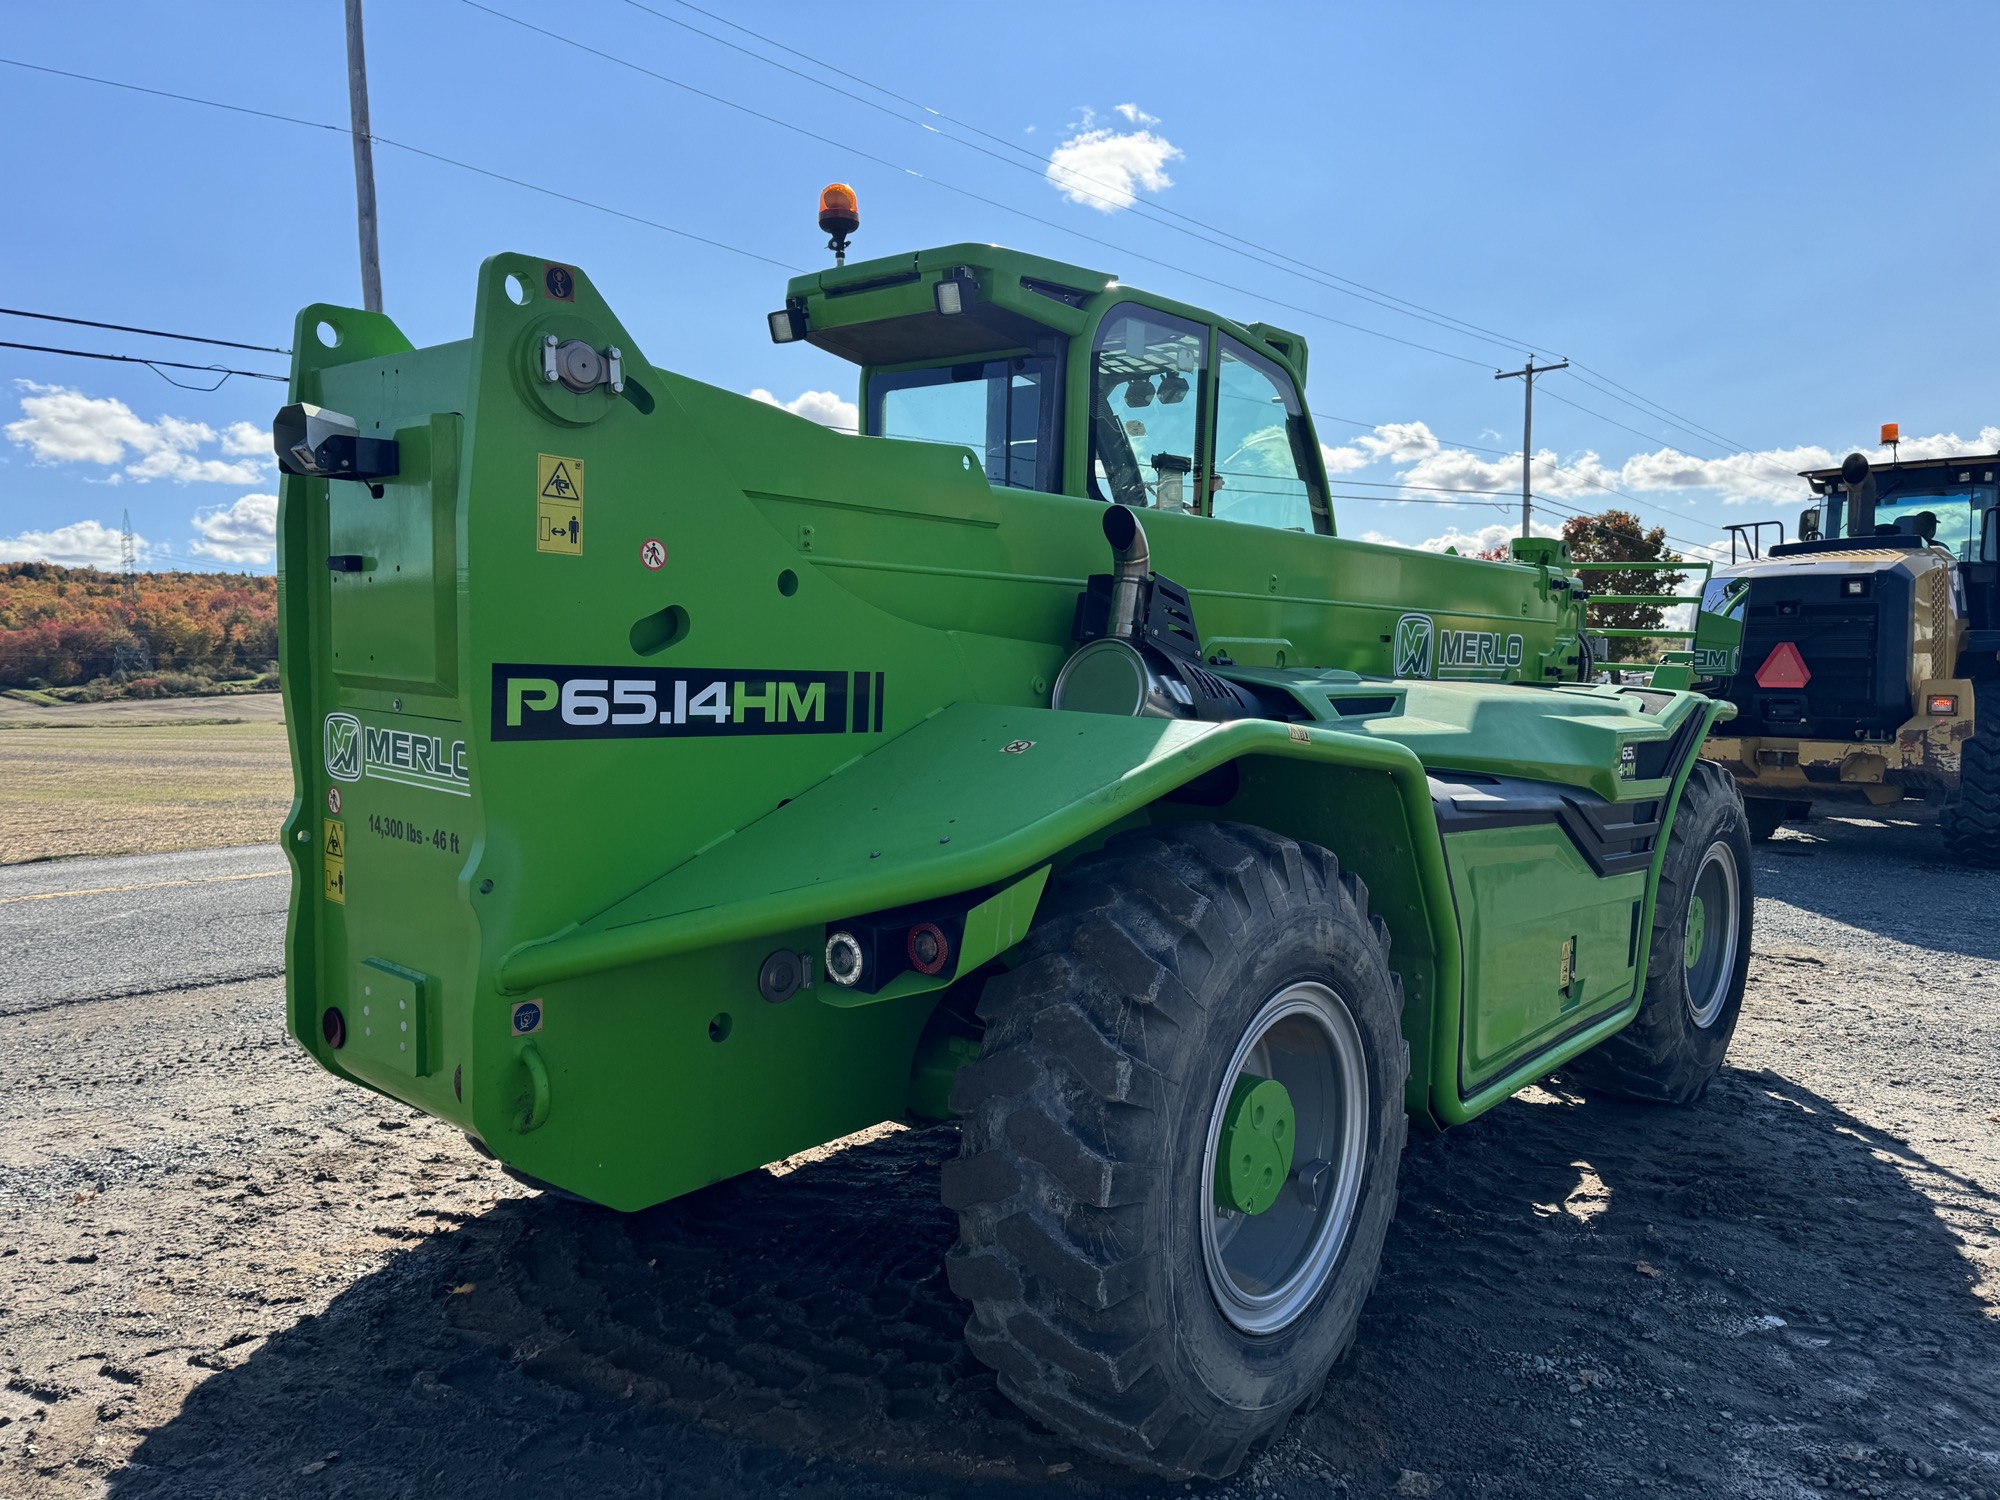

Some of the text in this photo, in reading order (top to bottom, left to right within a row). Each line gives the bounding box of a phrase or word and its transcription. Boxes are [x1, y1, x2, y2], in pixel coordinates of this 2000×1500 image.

[1439, 629, 1523, 667] MERLO
[506, 677, 826, 726] P65.14HM
[368, 813, 404, 840] 14,300
[406, 822, 423, 845] lbs
[432, 828, 447, 851] 46
[450, 832, 460, 855] ft
